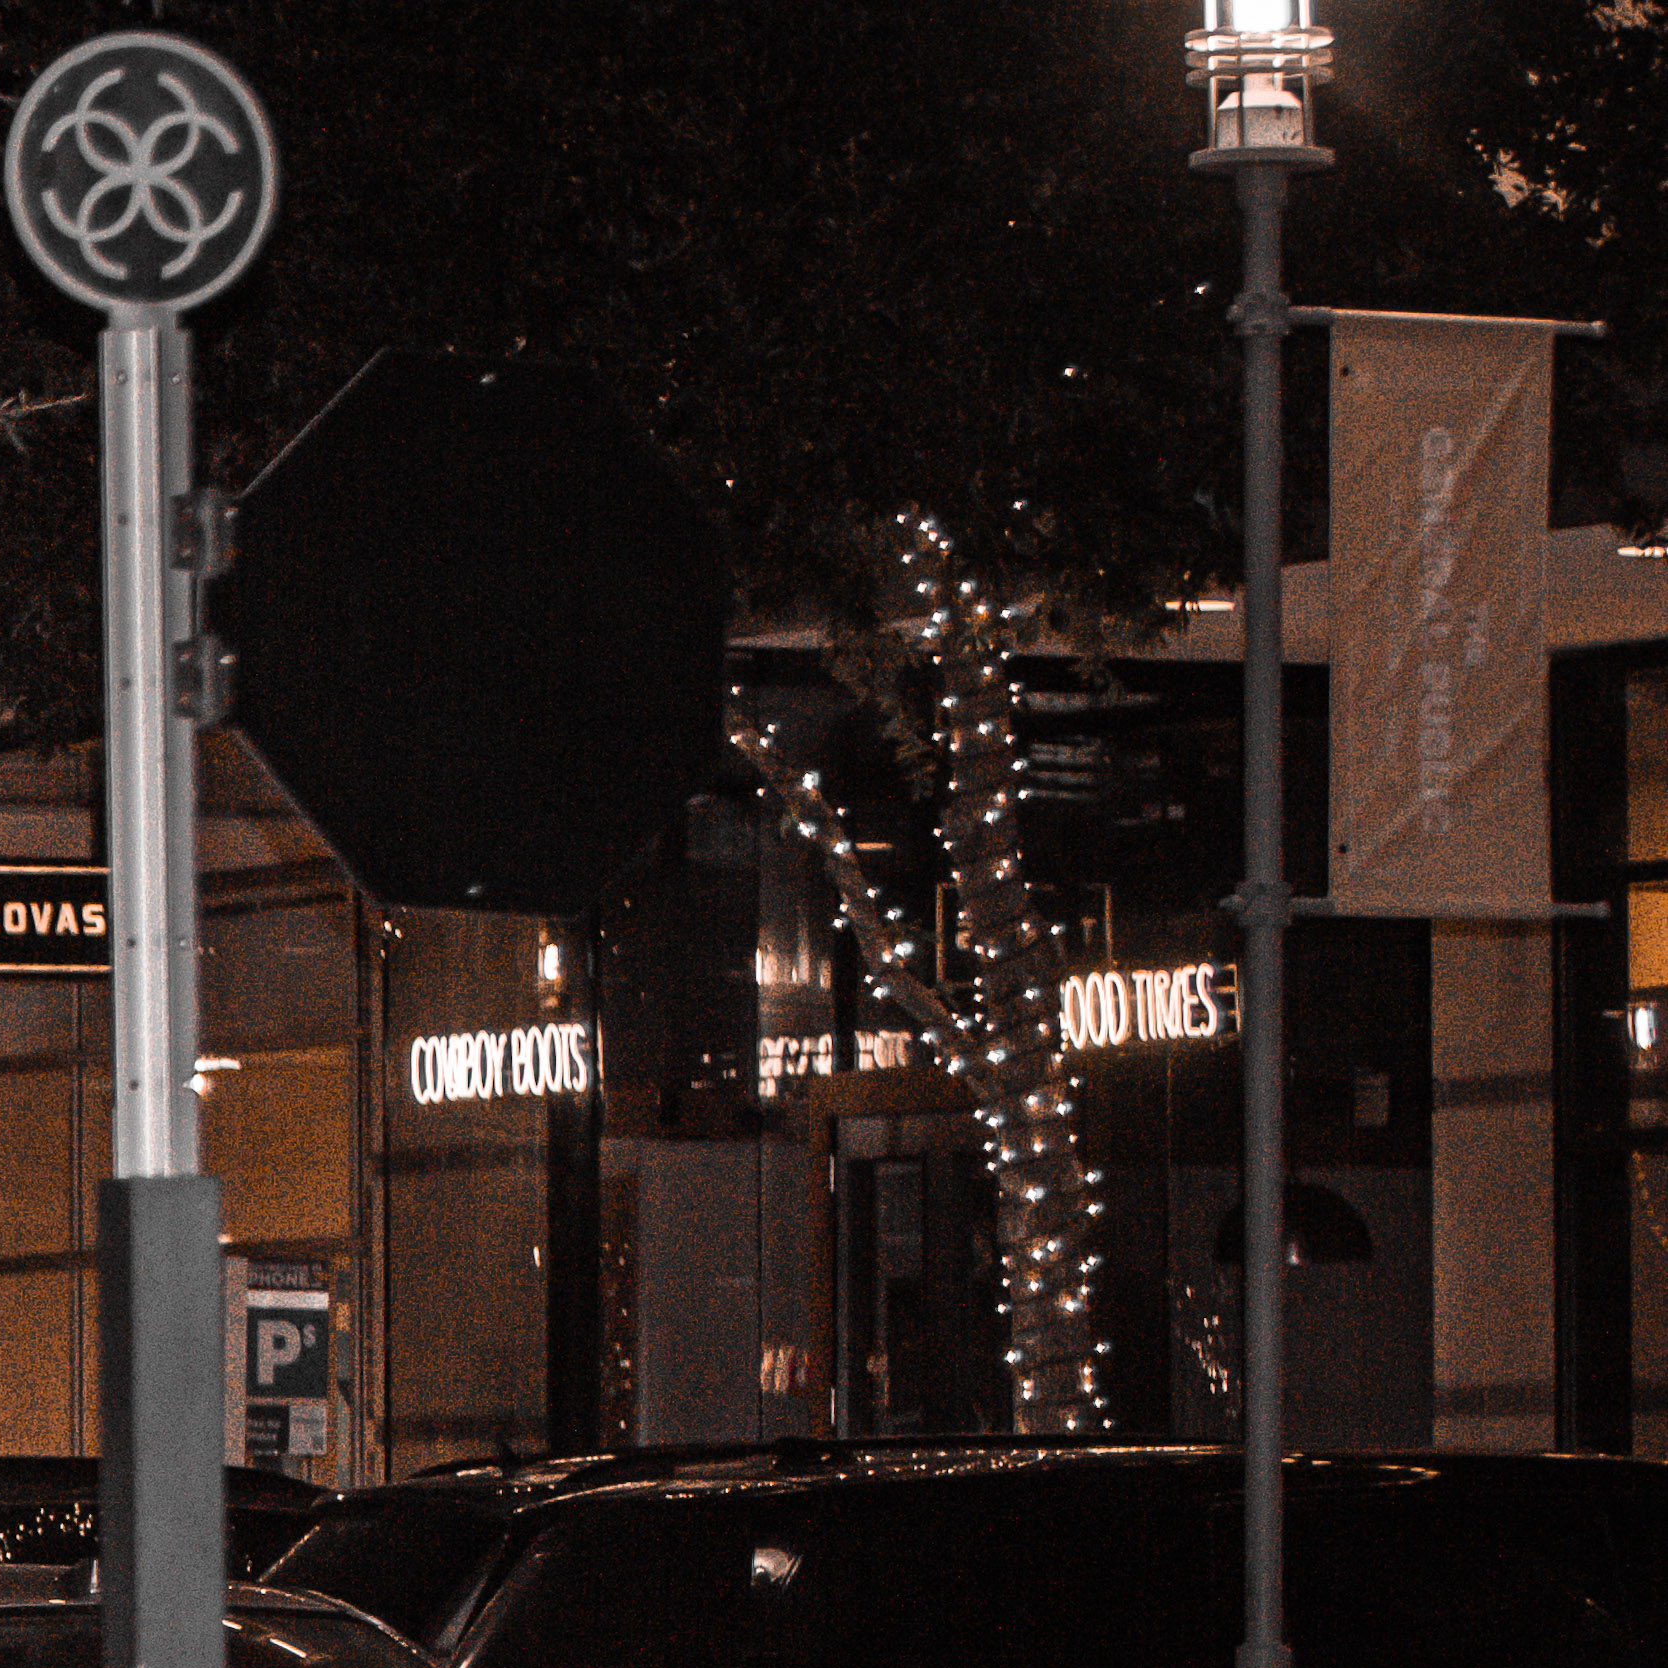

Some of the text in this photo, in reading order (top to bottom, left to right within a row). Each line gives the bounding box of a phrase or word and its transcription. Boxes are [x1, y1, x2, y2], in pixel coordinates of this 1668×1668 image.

[1060, 962, 1218, 1050] OOD TIMES
[411, 1022, 588, 1105] COWBOY BOOTS
